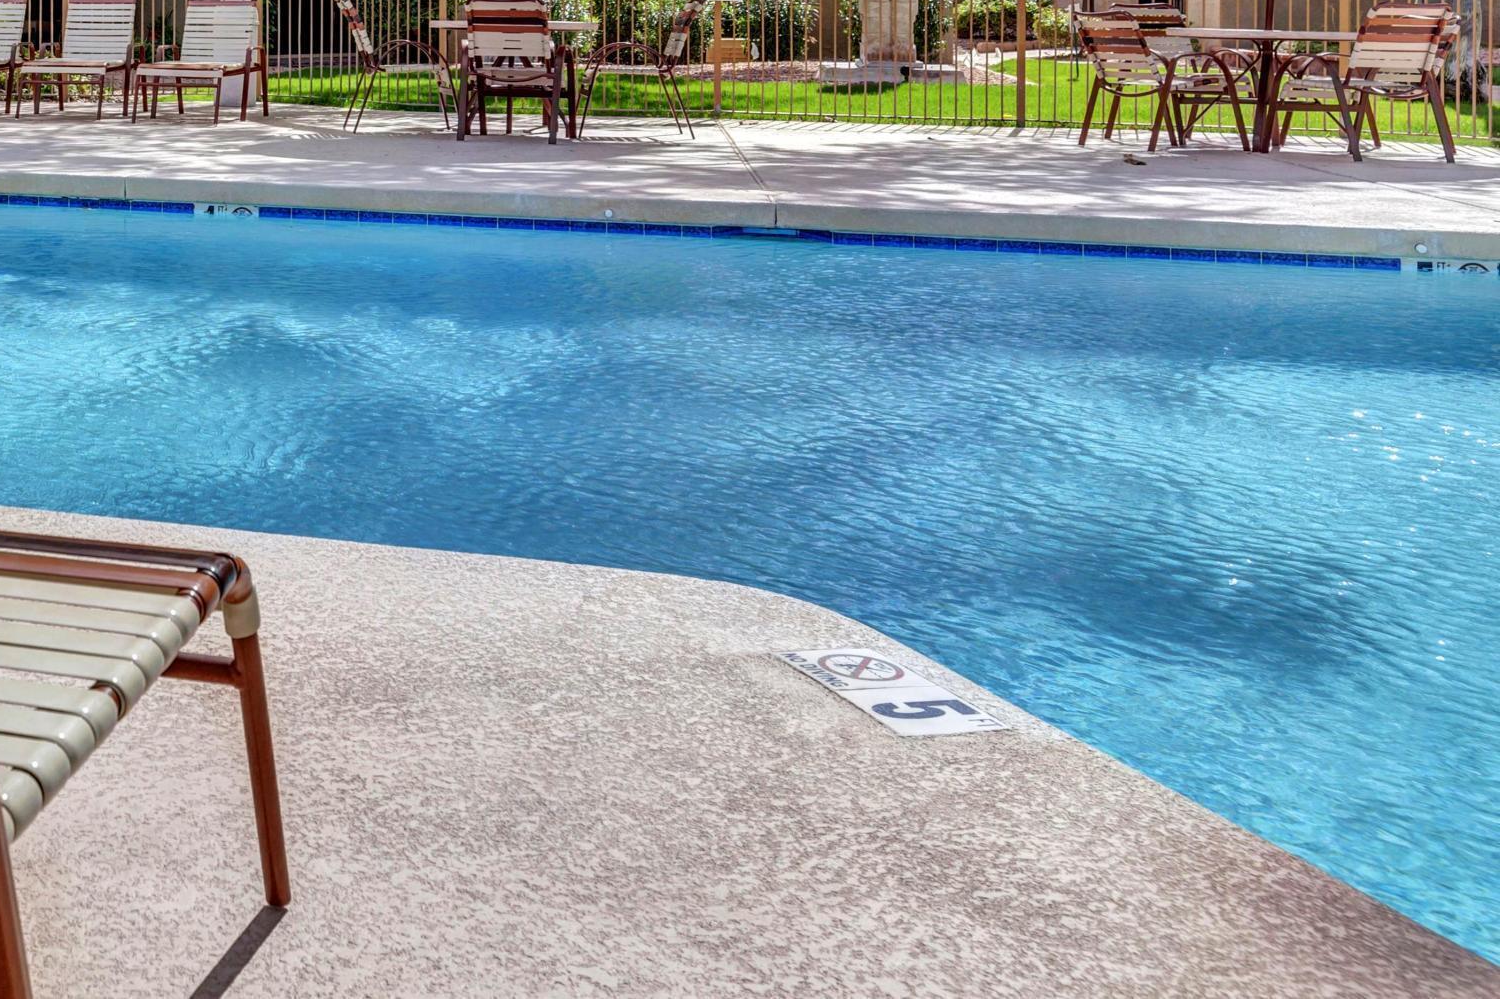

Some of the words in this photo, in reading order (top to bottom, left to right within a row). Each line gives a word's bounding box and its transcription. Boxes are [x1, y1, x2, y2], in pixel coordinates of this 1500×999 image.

[780, 653, 807, 662] NO
[799, 663, 849, 687] DIVING
[871, 699, 979, 719] 5
